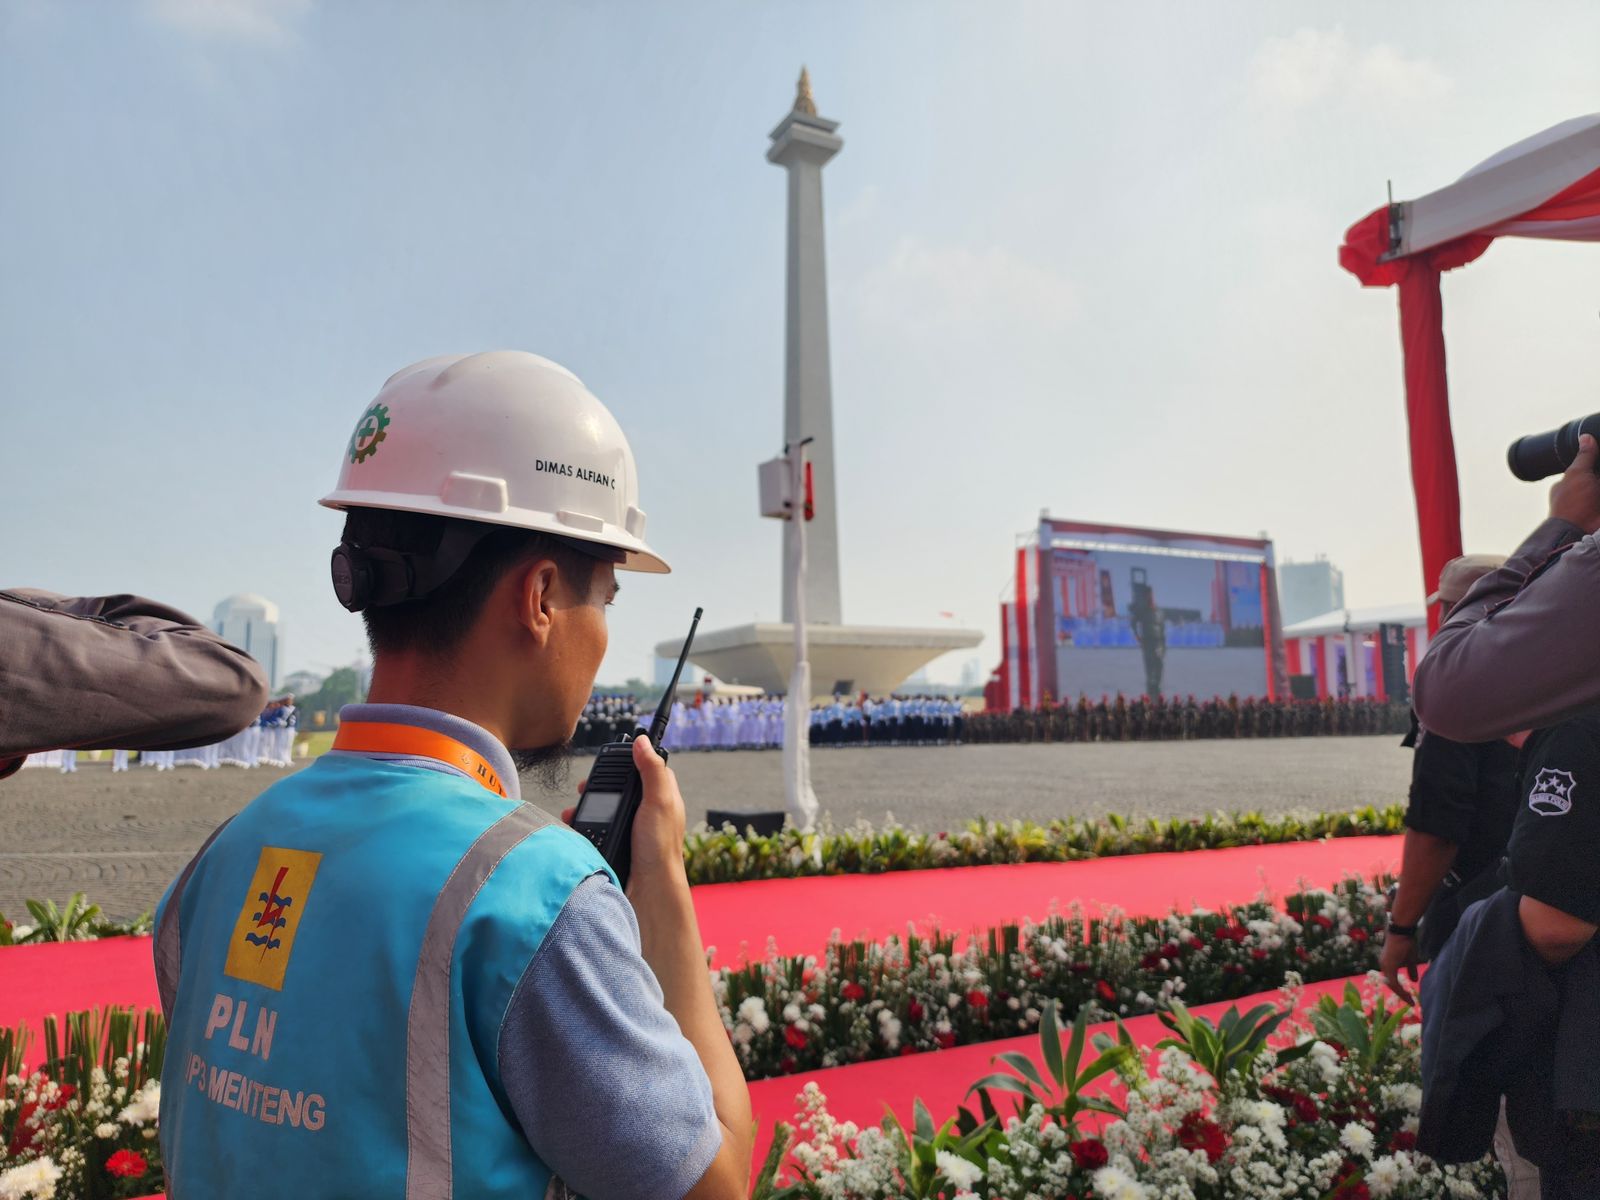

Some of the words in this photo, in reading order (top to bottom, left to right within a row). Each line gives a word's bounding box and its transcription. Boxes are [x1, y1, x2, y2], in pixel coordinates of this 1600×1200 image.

[535, 459, 573, 477] DIMAS
[576, 467, 609, 487] ALFIAN
[204, 993, 278, 1061] PLN
[208, 1066, 326, 1131] MENTENG
